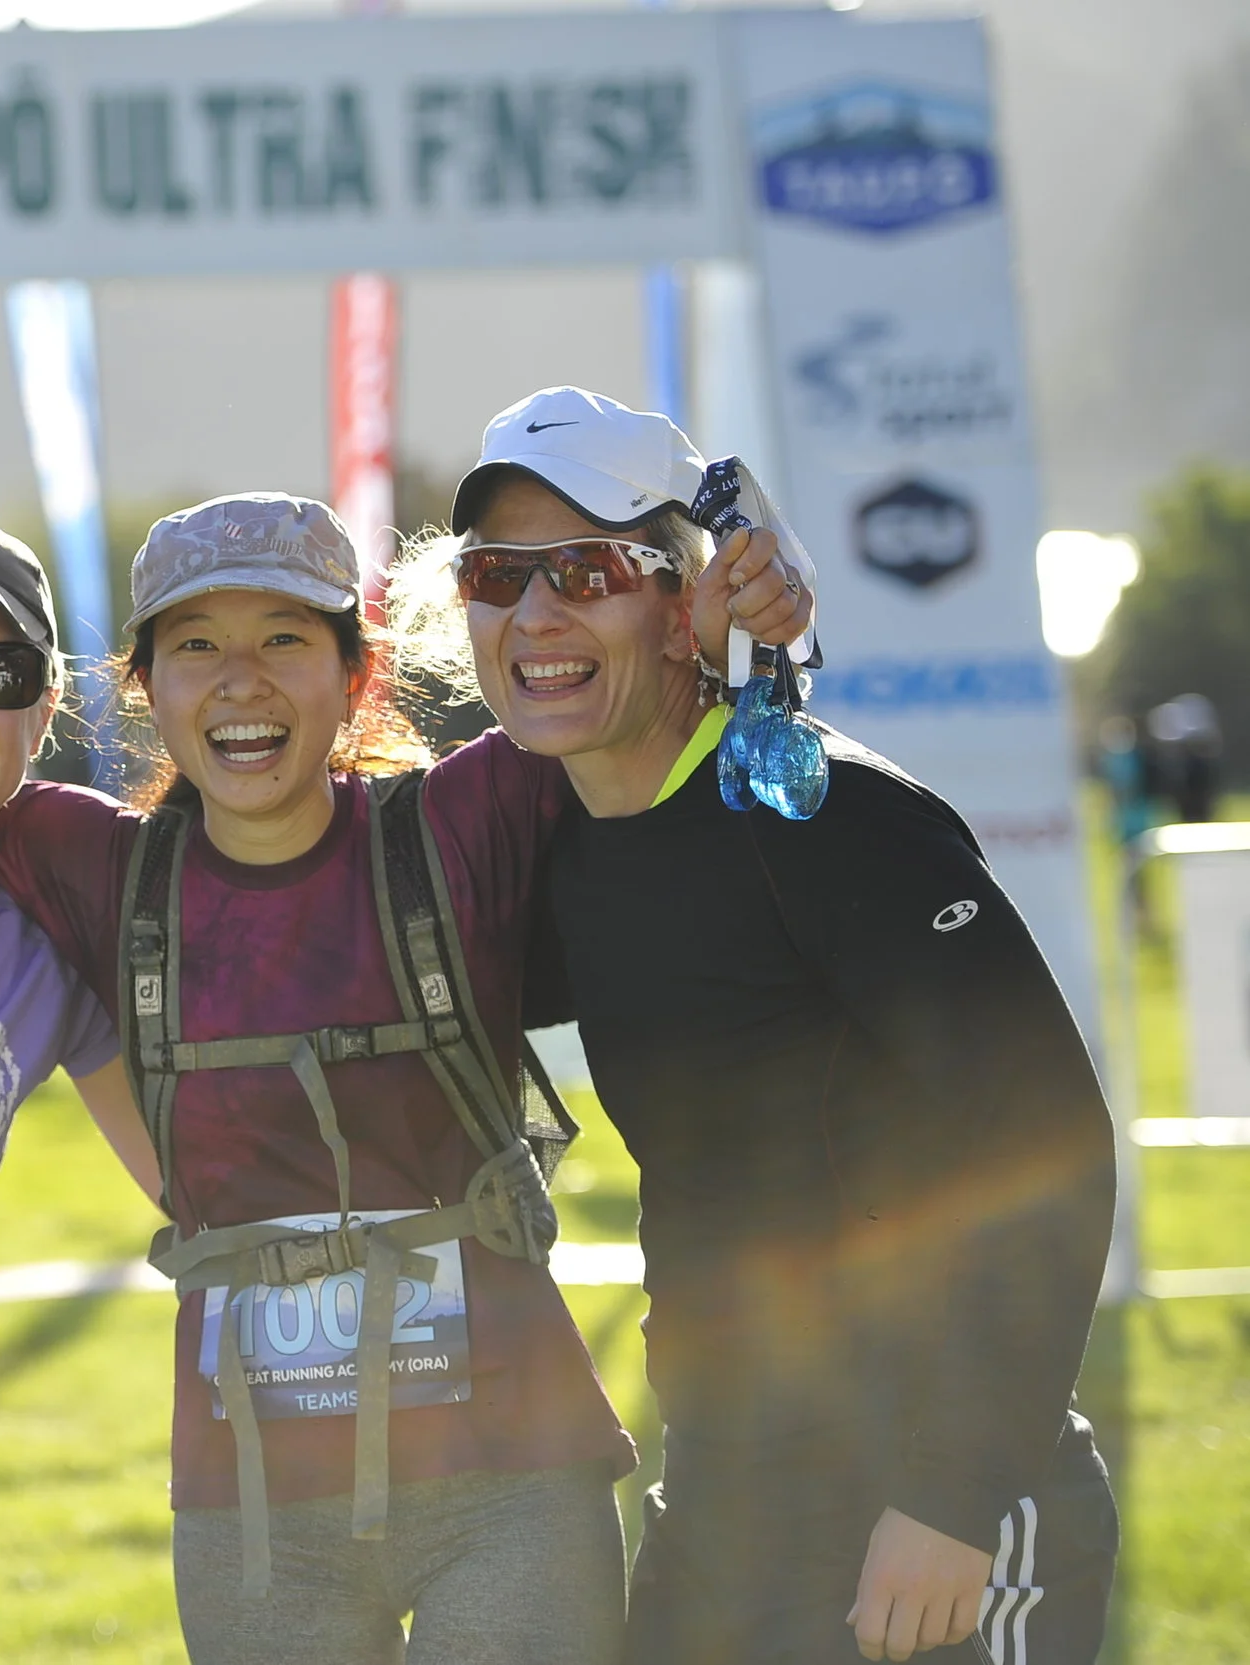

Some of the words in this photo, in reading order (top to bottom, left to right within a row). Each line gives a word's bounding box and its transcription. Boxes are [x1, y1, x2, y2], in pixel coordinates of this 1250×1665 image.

[92, 86, 375, 217] ULTRA
[405, 76, 690, 211] FINISH
[272, 1365, 334, 1383] RUNNING
[407, 1354, 449, 1373] (ORA)
[295, 1390, 358, 1411] TEAMS
